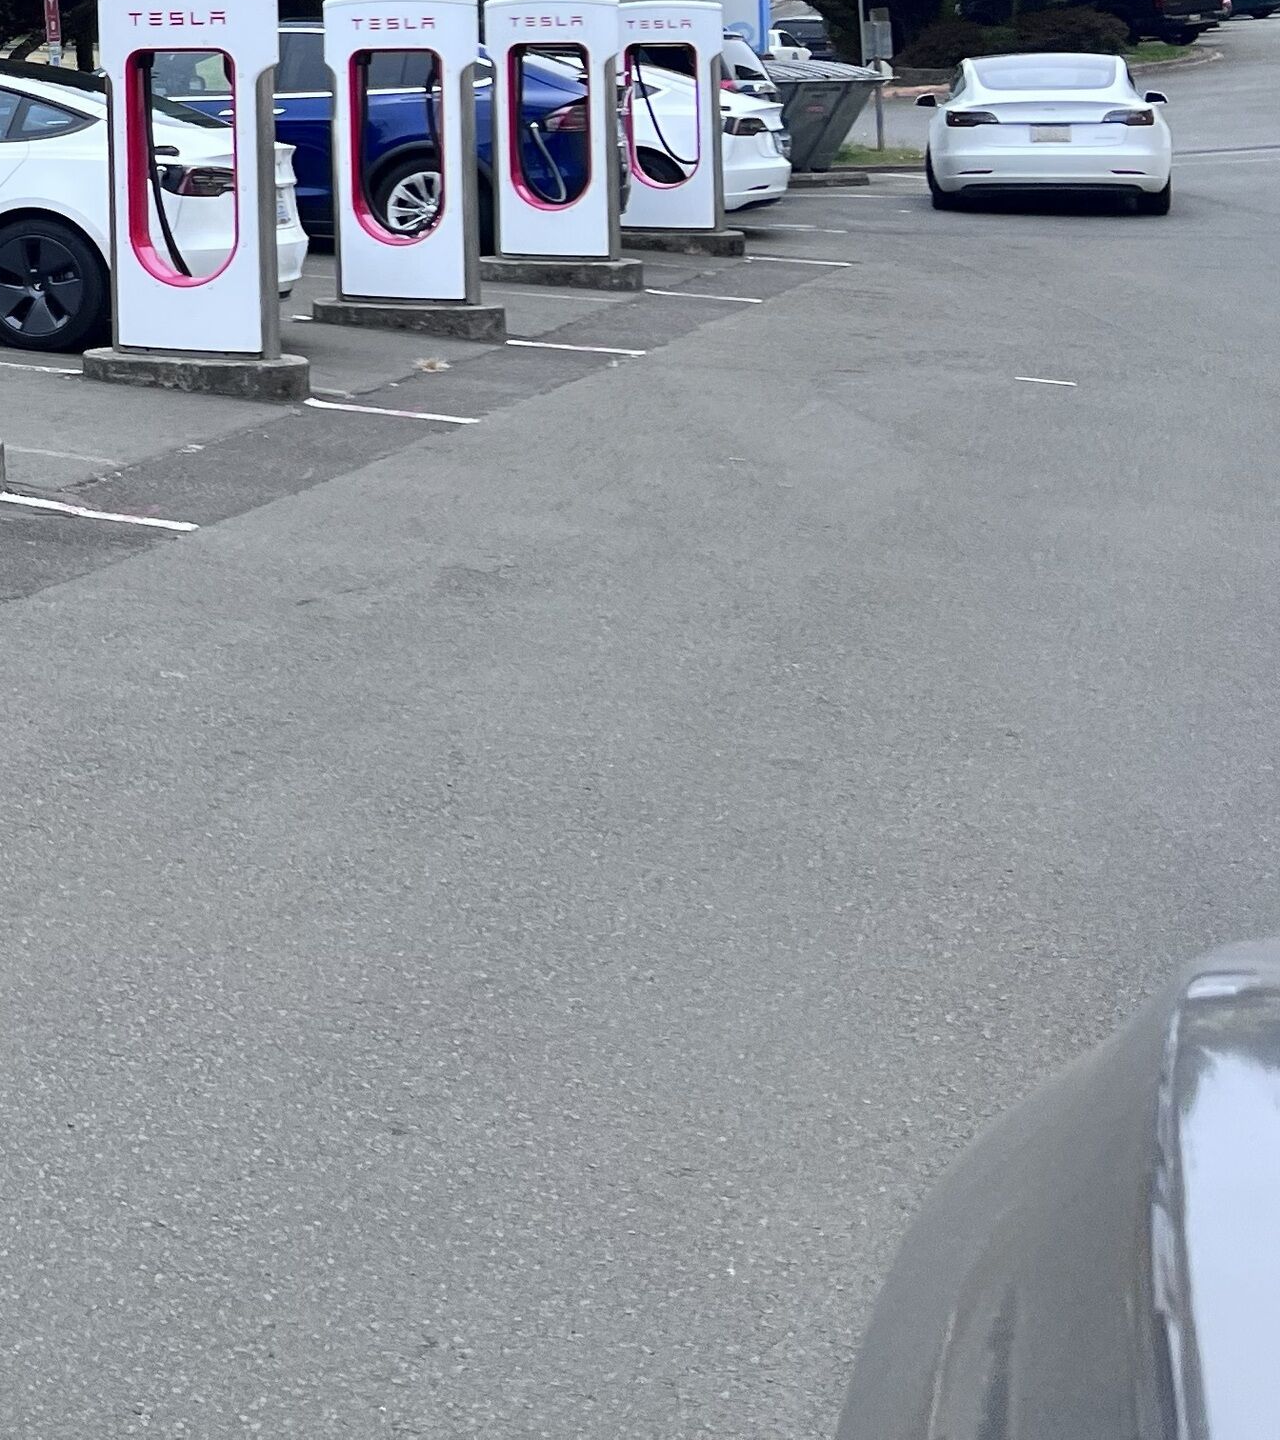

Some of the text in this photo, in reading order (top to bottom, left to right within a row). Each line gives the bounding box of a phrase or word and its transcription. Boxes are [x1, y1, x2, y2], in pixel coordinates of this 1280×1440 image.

[128, 11, 225, 26] TESLA
[351, 17, 436, 30] TESLA
[509, 15, 584, 27] TESLA
[626, 19, 692, 30] TESLA
